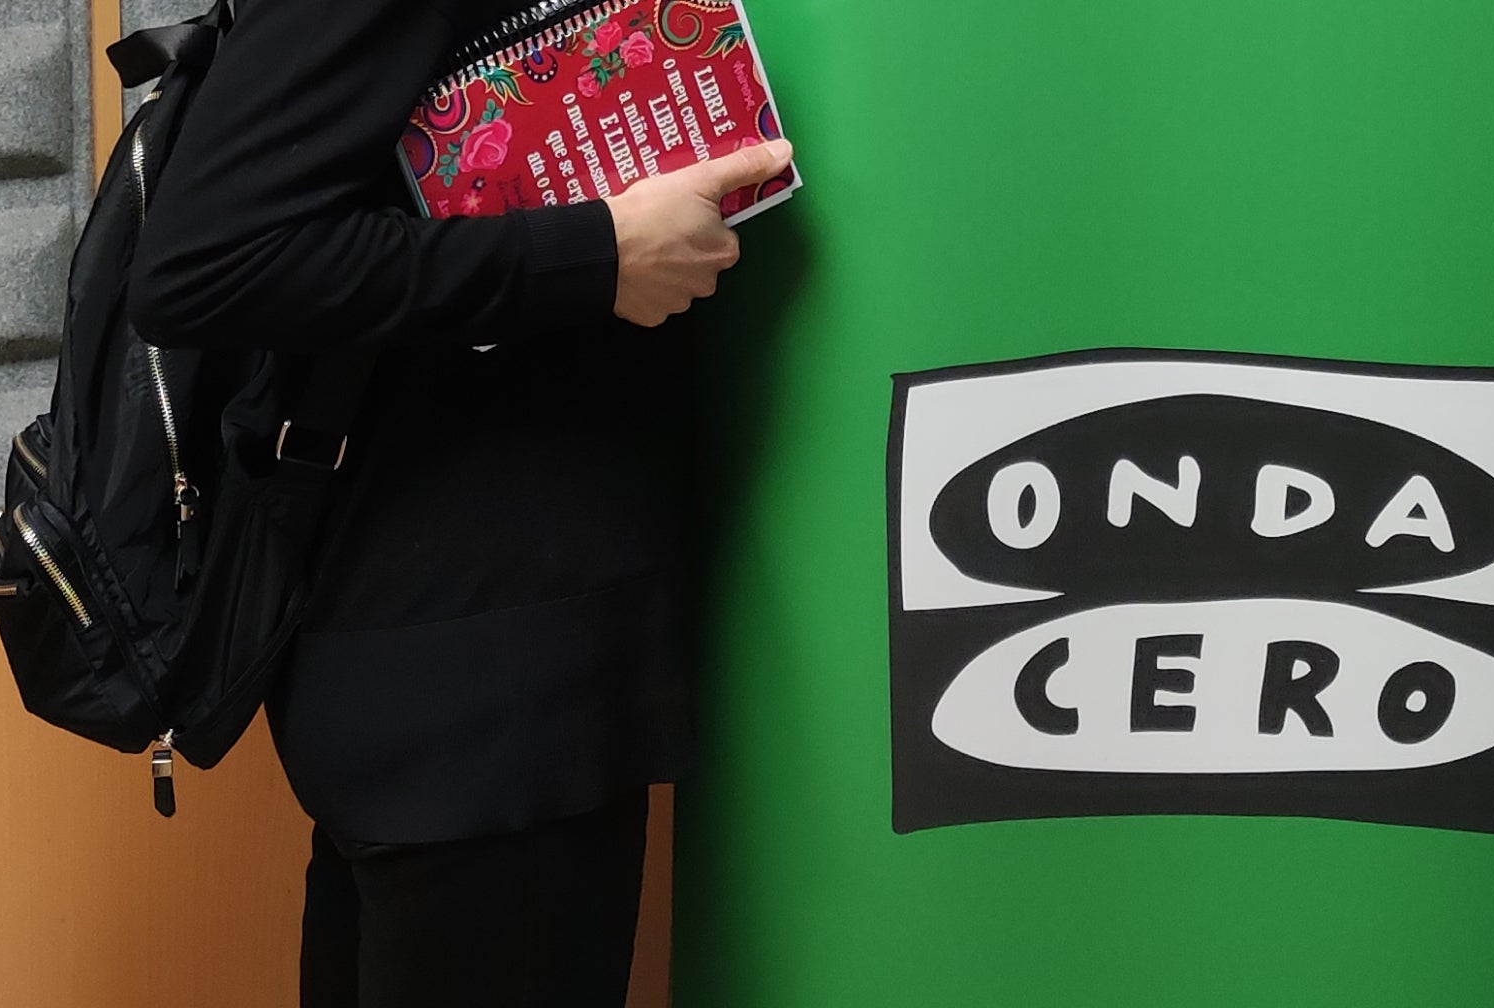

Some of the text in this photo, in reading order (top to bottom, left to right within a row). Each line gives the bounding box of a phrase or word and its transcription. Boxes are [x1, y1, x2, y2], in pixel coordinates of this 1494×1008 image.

[662, 58, 676, 70] o
[667, 69, 689, 107] meu
[618, 91, 632, 105] a
[623, 103, 649, 146] miña
[648, 93, 683, 152] LIBRE
[693, 65, 737, 137] LIBRE É
[545, 130, 589, 206] que se erg
[562, 93, 612, 200] o meu pensam
[599, 111, 639, 185] E LIBRE
[527, 152, 558, 207] ata o ce
[987, 455, 1456, 553] ONDA
[1013, 632, 1457, 745] CERO
